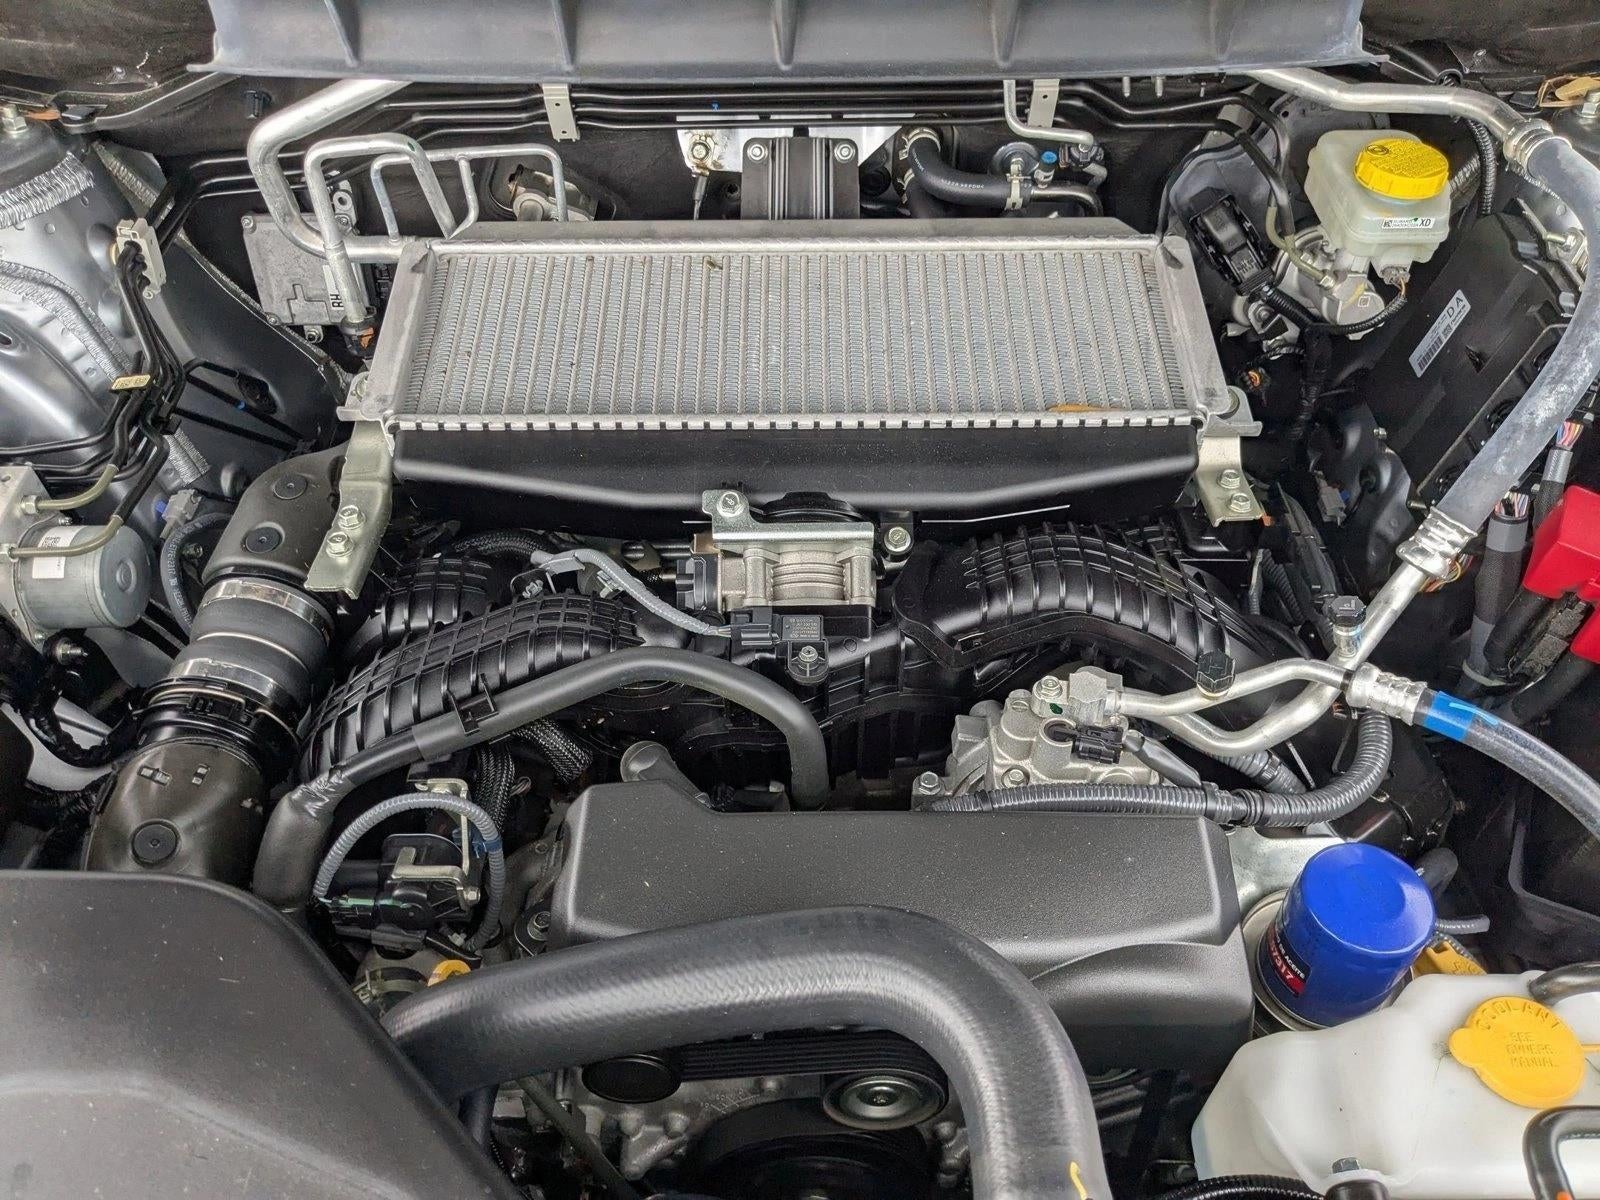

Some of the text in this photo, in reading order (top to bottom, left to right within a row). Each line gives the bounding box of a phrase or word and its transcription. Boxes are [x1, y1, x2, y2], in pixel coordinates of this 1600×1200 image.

[1420, 218, 1431, 227] XD
[330, 293, 345, 308] RH
[1284, 955, 1306, 979] ACEITE
[1475, 1000, 1561, 1030] COOLANT
